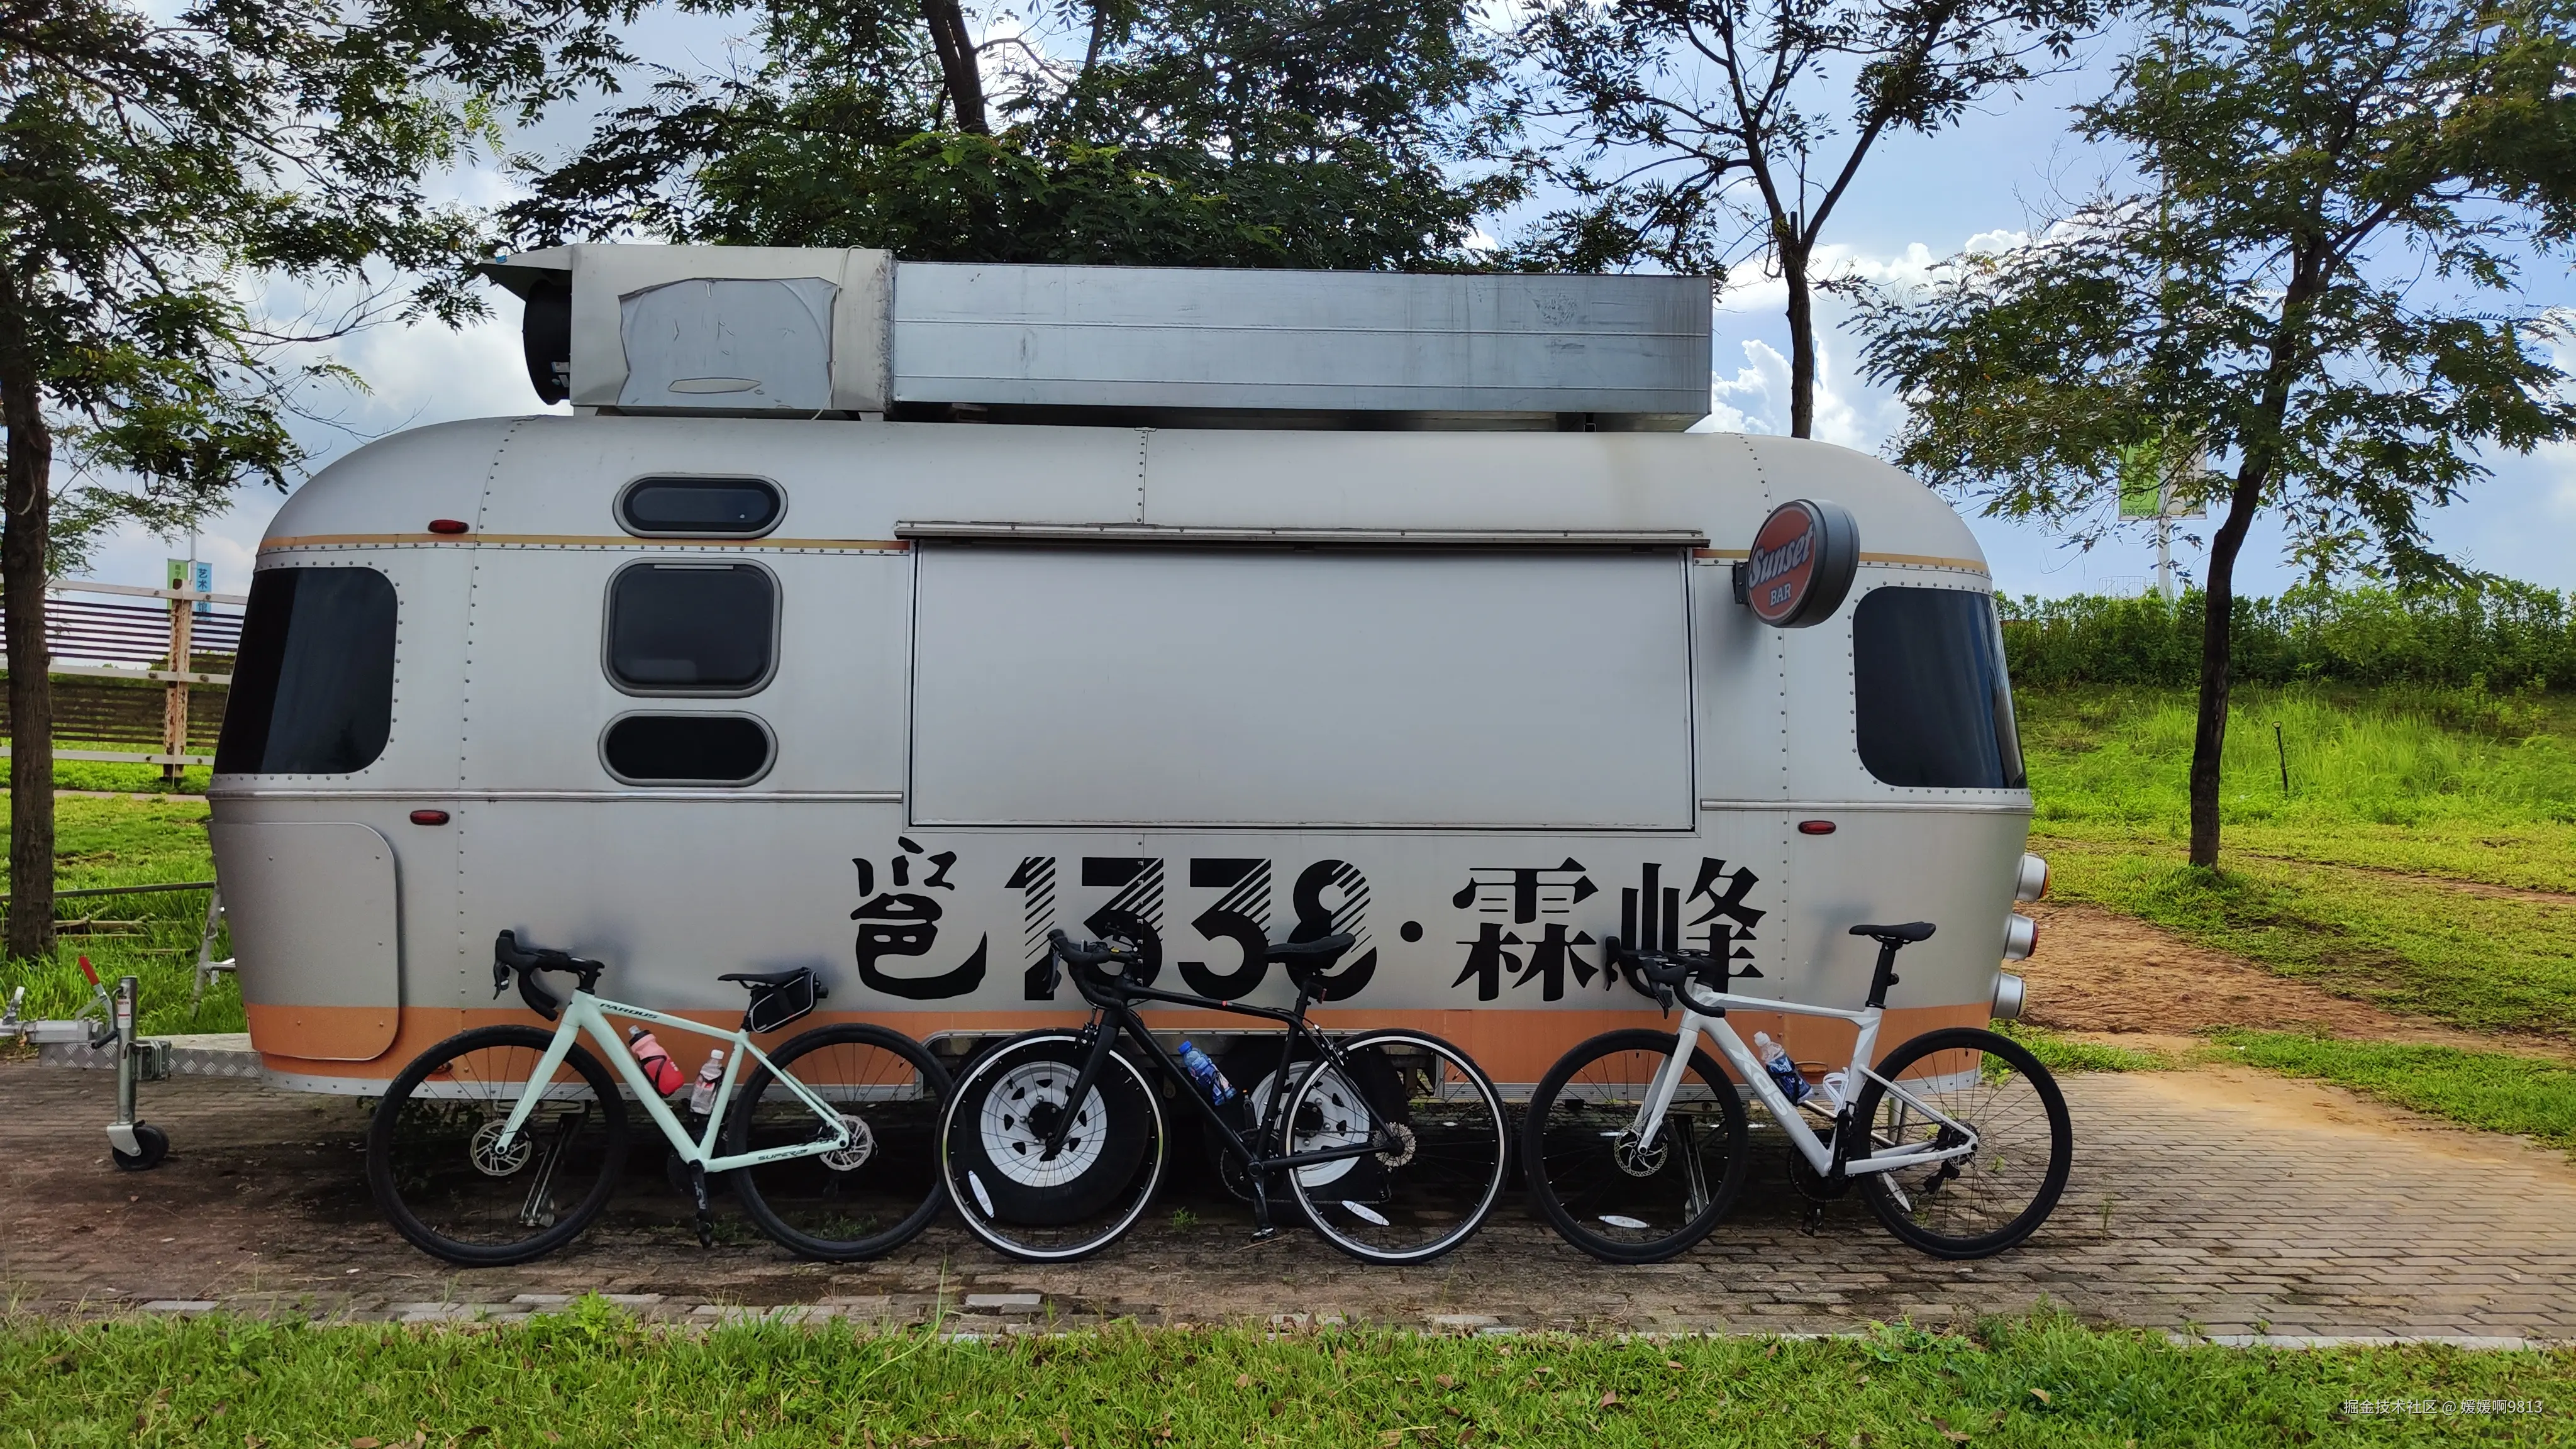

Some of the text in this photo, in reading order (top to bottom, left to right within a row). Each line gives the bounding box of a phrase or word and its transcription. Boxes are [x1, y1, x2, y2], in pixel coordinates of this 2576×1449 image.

[1748, 523, 1814, 588] Sunset
[1770, 582, 1792, 607] BAR
[599, 1003, 659, 1019] PARDUS
[1728, 1046, 1792, 1116] XDS
